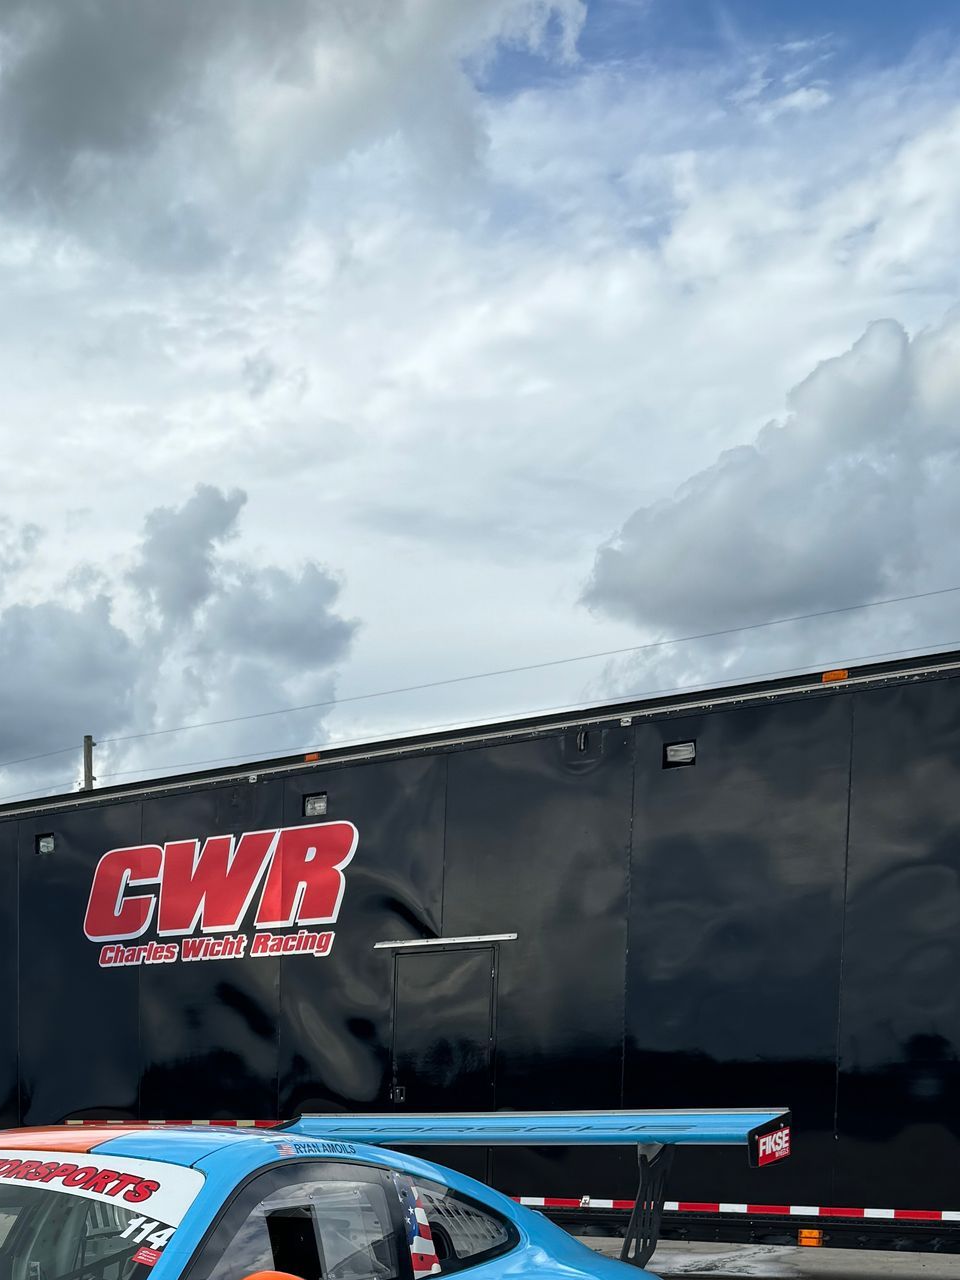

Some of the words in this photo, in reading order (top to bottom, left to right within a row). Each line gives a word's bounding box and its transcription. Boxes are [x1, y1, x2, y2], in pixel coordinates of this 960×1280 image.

[84, 821, 358, 941] CWR
[99, 943, 178, 967] Charles
[181, 935, 247, 961] Wicht
[250, 931, 335, 957] Racing
[328, 1124, 697, 1133] PORSCHE
[759, 1129, 790, 1157] FIKSE
[294, 1144, 320, 1153] RYAN
[321, 1144, 356, 1154] AMOILS
[119, 1216, 176, 1250] 114
